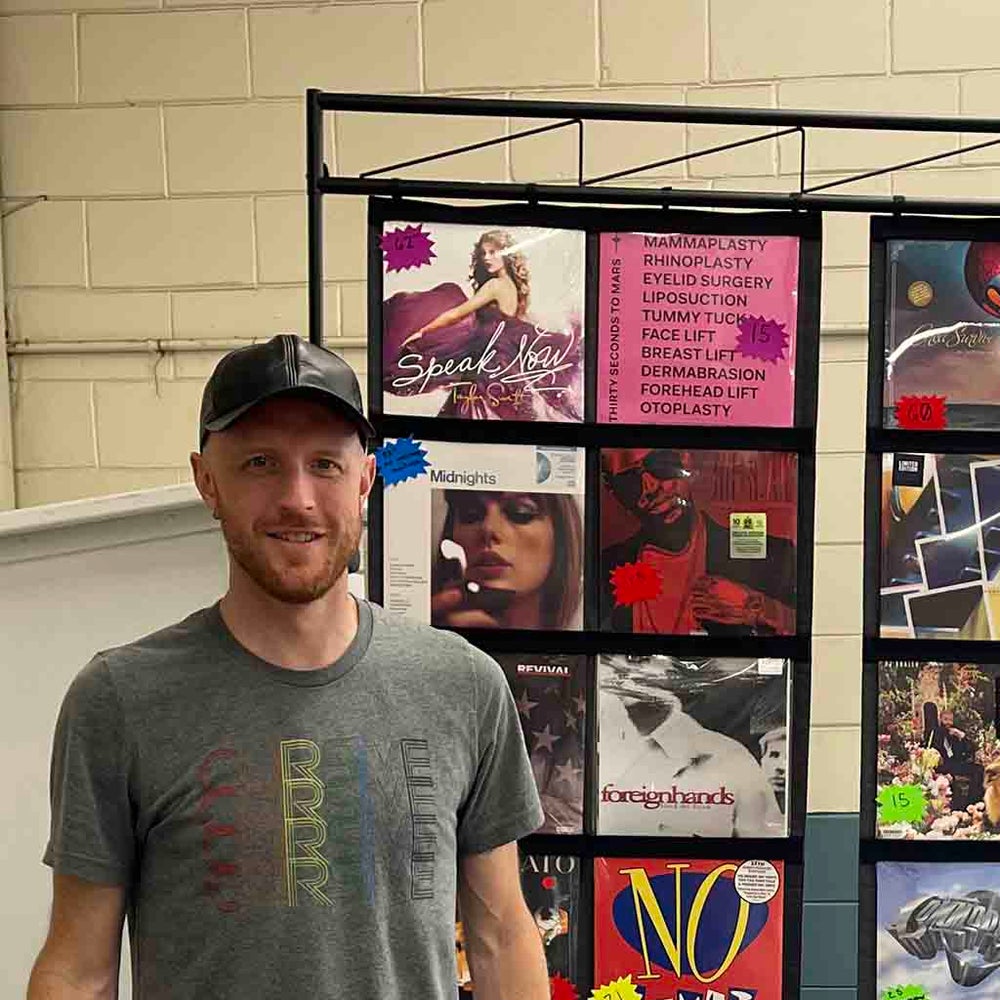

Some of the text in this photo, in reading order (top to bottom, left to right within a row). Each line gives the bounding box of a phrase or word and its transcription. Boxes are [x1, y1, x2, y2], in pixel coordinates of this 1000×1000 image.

[644, 235, 768, 251] MAMMAPLASTY
[643, 254, 753, 270] RHINOPLASTY
[643, 272, 774, 289] EYELID SURGERY
[642, 291, 748, 307] LIPOSUCTION
[642, 309, 746, 326] TUMMY TUCK
[608, 258, 621, 422] THIRTY SECONDS TO MARS
[642, 328, 716, 343] FACE LIFT
[751, 324, 771, 344] 15
[392, 321, 574, 393] Speak Now
[642, 346, 737, 362] BREAST LIFT
[641, 364, 766, 382] DERMABRASION
[640, 383, 759, 400] FOREHEAD LIFT
[640, 401, 732, 417] OTOPLASTY
[430, 470, 497, 486] Midnights
[516, 664, 571, 676] REVIVAL
[601, 783, 735, 810] foreignhands
[618, 863, 750, 983] NO
